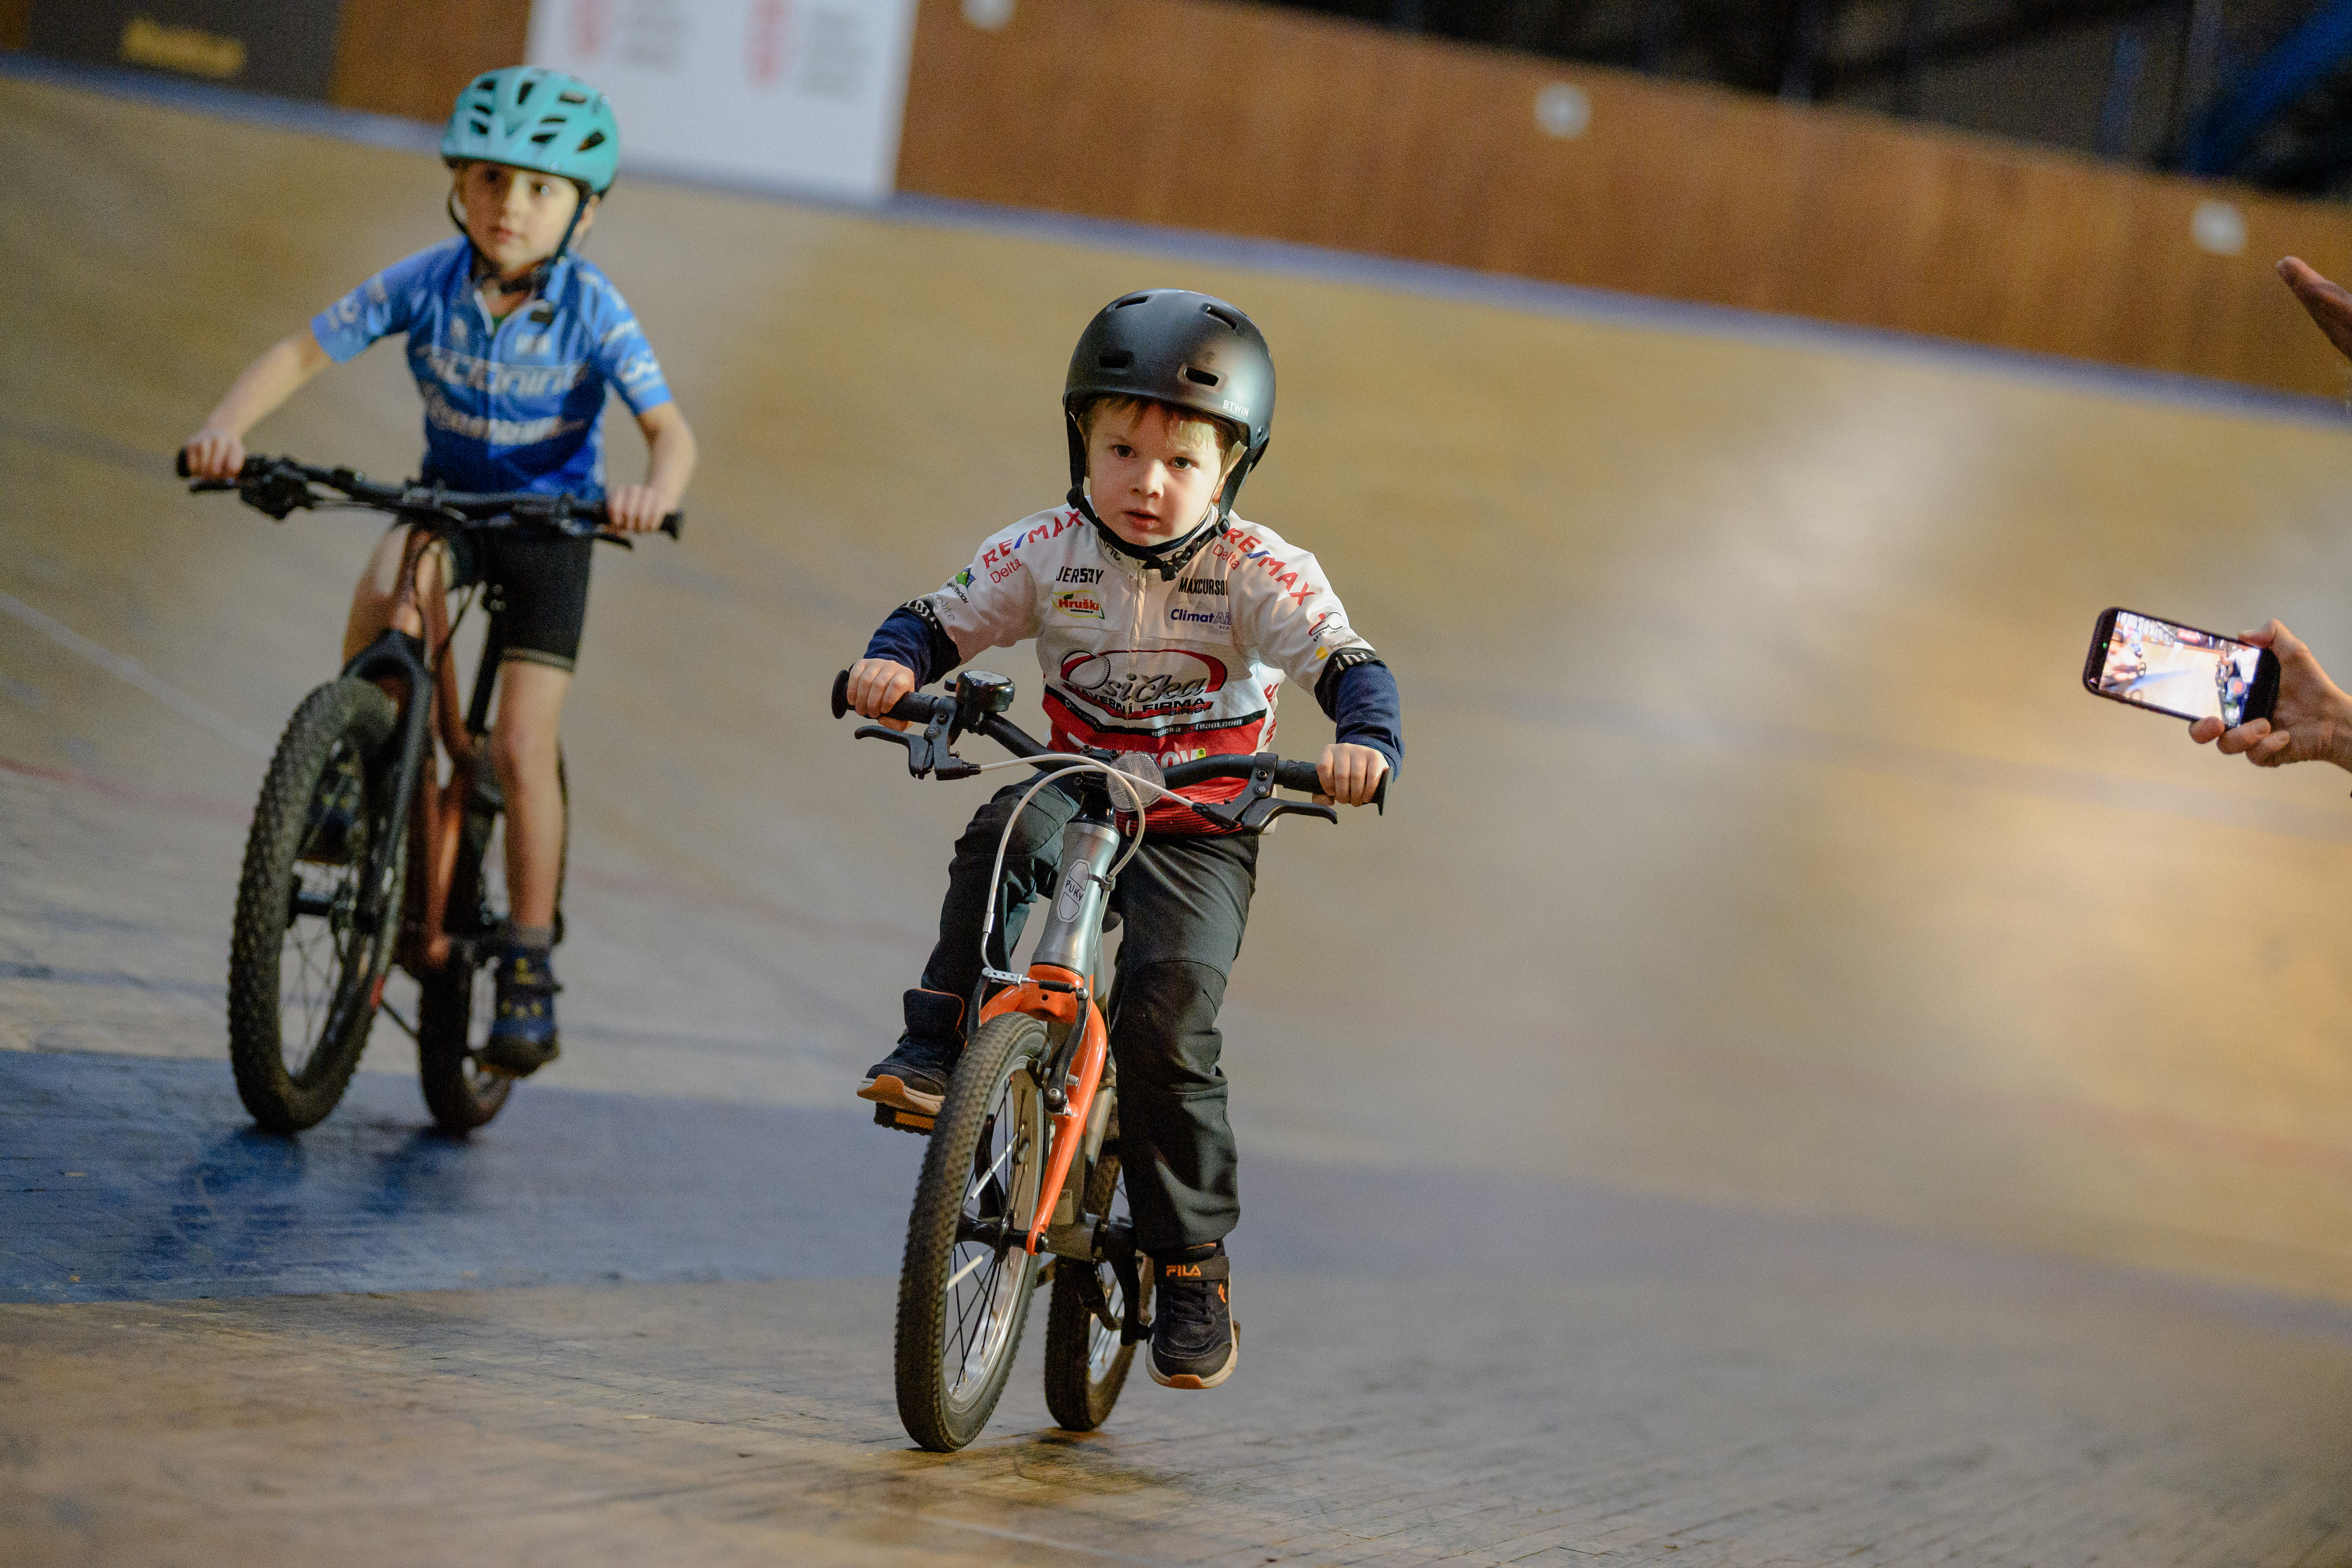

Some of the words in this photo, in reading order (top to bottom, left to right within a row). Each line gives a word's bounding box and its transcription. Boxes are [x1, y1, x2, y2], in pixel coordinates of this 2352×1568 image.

[1223, 399, 1249, 417] BTWIN
[982, 510, 1084, 569] RE/MAX
[1212, 543, 1240, 570] Delta
[1222, 527, 1317, 606] RE/MAX
[990, 558, 1022, 584] Delta
[1058, 599, 1100, 612] Hruška
[1057, 649, 1207, 702] Osička
[1142, 697, 1206, 713] FIRMA
[1168, 706, 1206, 716] S.R.O.
[1065, 879, 1083, 901] PUKY
[1166, 1264, 1202, 1277] FILA
